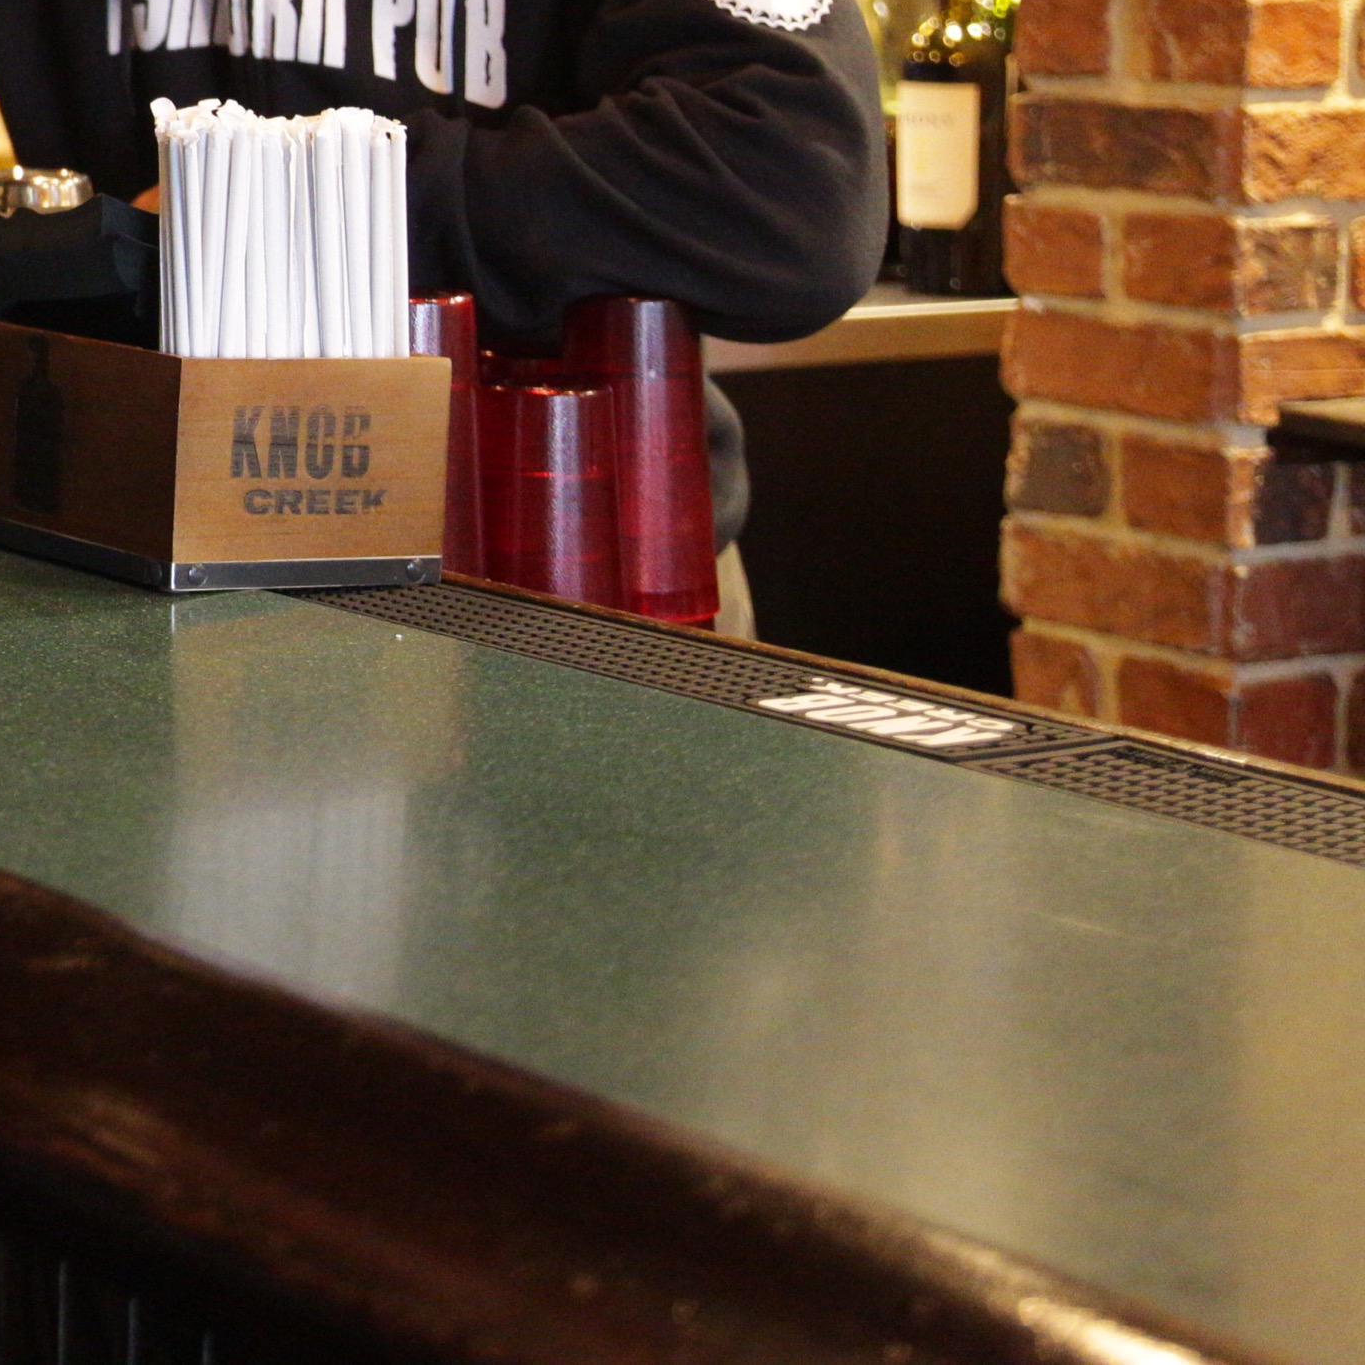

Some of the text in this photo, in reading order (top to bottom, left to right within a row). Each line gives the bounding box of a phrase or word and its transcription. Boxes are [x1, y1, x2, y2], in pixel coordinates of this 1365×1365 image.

[230, 405, 372, 480] KNOB
[244, 488, 388, 515] CREEK
[758, 693, 1004, 747] KNOB
